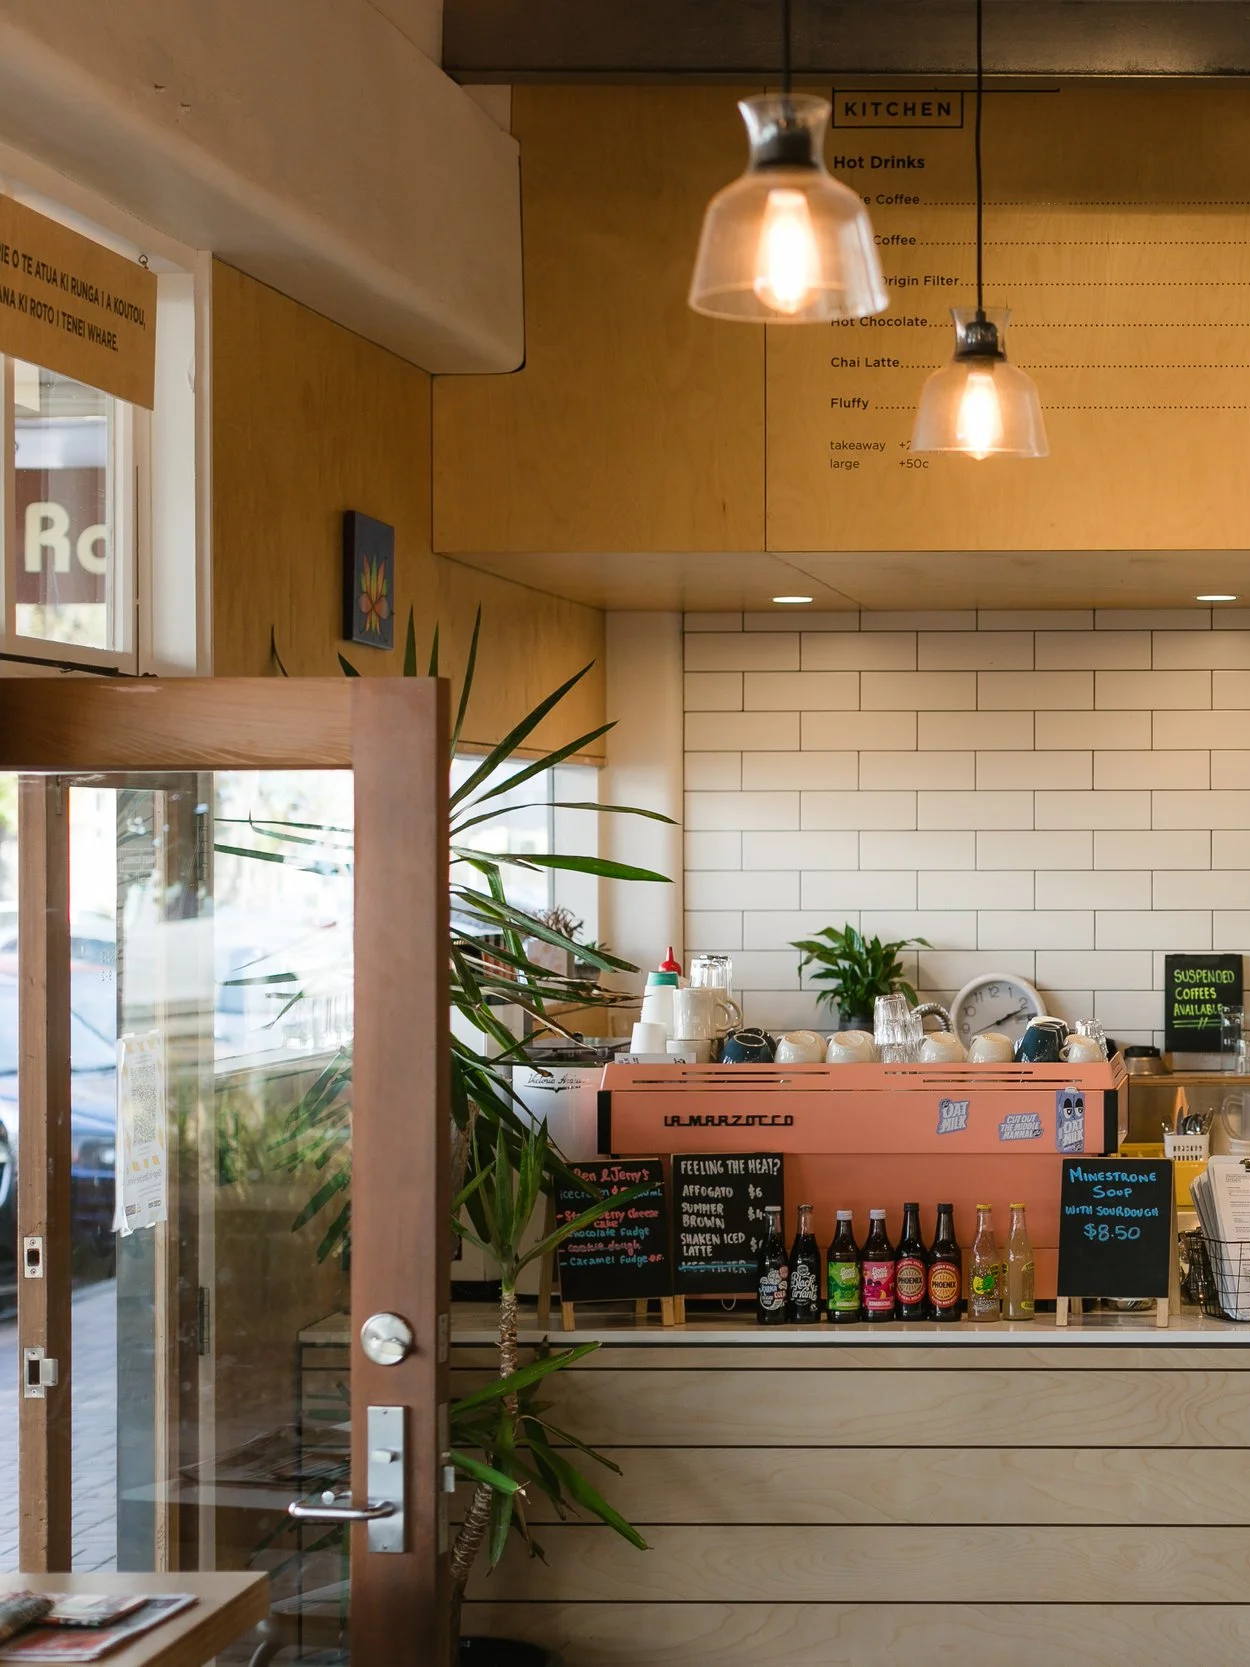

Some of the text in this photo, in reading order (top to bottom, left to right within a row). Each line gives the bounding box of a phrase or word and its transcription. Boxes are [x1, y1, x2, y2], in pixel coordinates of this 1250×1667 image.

[845, 102, 950, 116] KITCHEN
[833, 156, 925, 169] Hot Drinks
[876, 194, 920, 205] Coffee
[873, 235, 916, 245] Coffee
[924, 276, 959, 286] Filter
[12, 250, 19, 268] O
[22, 253, 32, 275] TE
[35, 261, 58, 287] ATUA
[60, 271, 68, 292] KI
[71, 277, 99, 306] RUNGA
[106, 294, 112, 312] A
[114, 297, 146, 331] KOUTOU,
[19, 292, 28, 313] KI
[30, 298, 54, 324] ROTO
[62, 311, 85, 338] TENEI
[88, 322, 118, 352] WHARE.
[860, 316, 928, 327] Chocolate
[831, 357, 860, 368] Chai
[865, 357, 900, 368] Latte
[831, 398, 869, 410] Fluffy
[830, 440, 886, 451] takeaway
[830, 459, 929, 470] large +50c
[1174, 969, 1235, 984] SUSPENDED
[974, 992, 983, 1004] 11
[988, 986, 1000, 998] 12
[1175, 987, 1217, 1000] COFFEES
[1019, 997, 1028, 1009] 2
[1174, 1003, 1222, 1016] AVAILABLE
[964, 1005, 976, 1017] 10
[942, 1101, 968, 1118] OAT
[939, 1115, 966, 1133] MILK
[1000, 1122, 1040, 1132] THE MIDDLE
[1064, 1118, 1084, 1133] OAT
[1063, 1131, 1084, 1146] MILK
[681, 1158, 781, 1175] FEELING THE HEAT?
[610, 1166, 650, 1183] Jerry's
[1069, 1167, 1157, 1183] MINESTRONE
[682, 1184, 763, 1199] AFFOGATO $6
[682, 1202, 724, 1215] SUMMER
[1096, 1206, 1159, 1217] SOURDOUGH
[682, 1215, 725, 1229] BROWN
[681, 1232, 746, 1245] SHAKEN ICED
[1083, 1223, 1141, 1241] $8.50
[683, 1245, 713, 1257] LATTE
